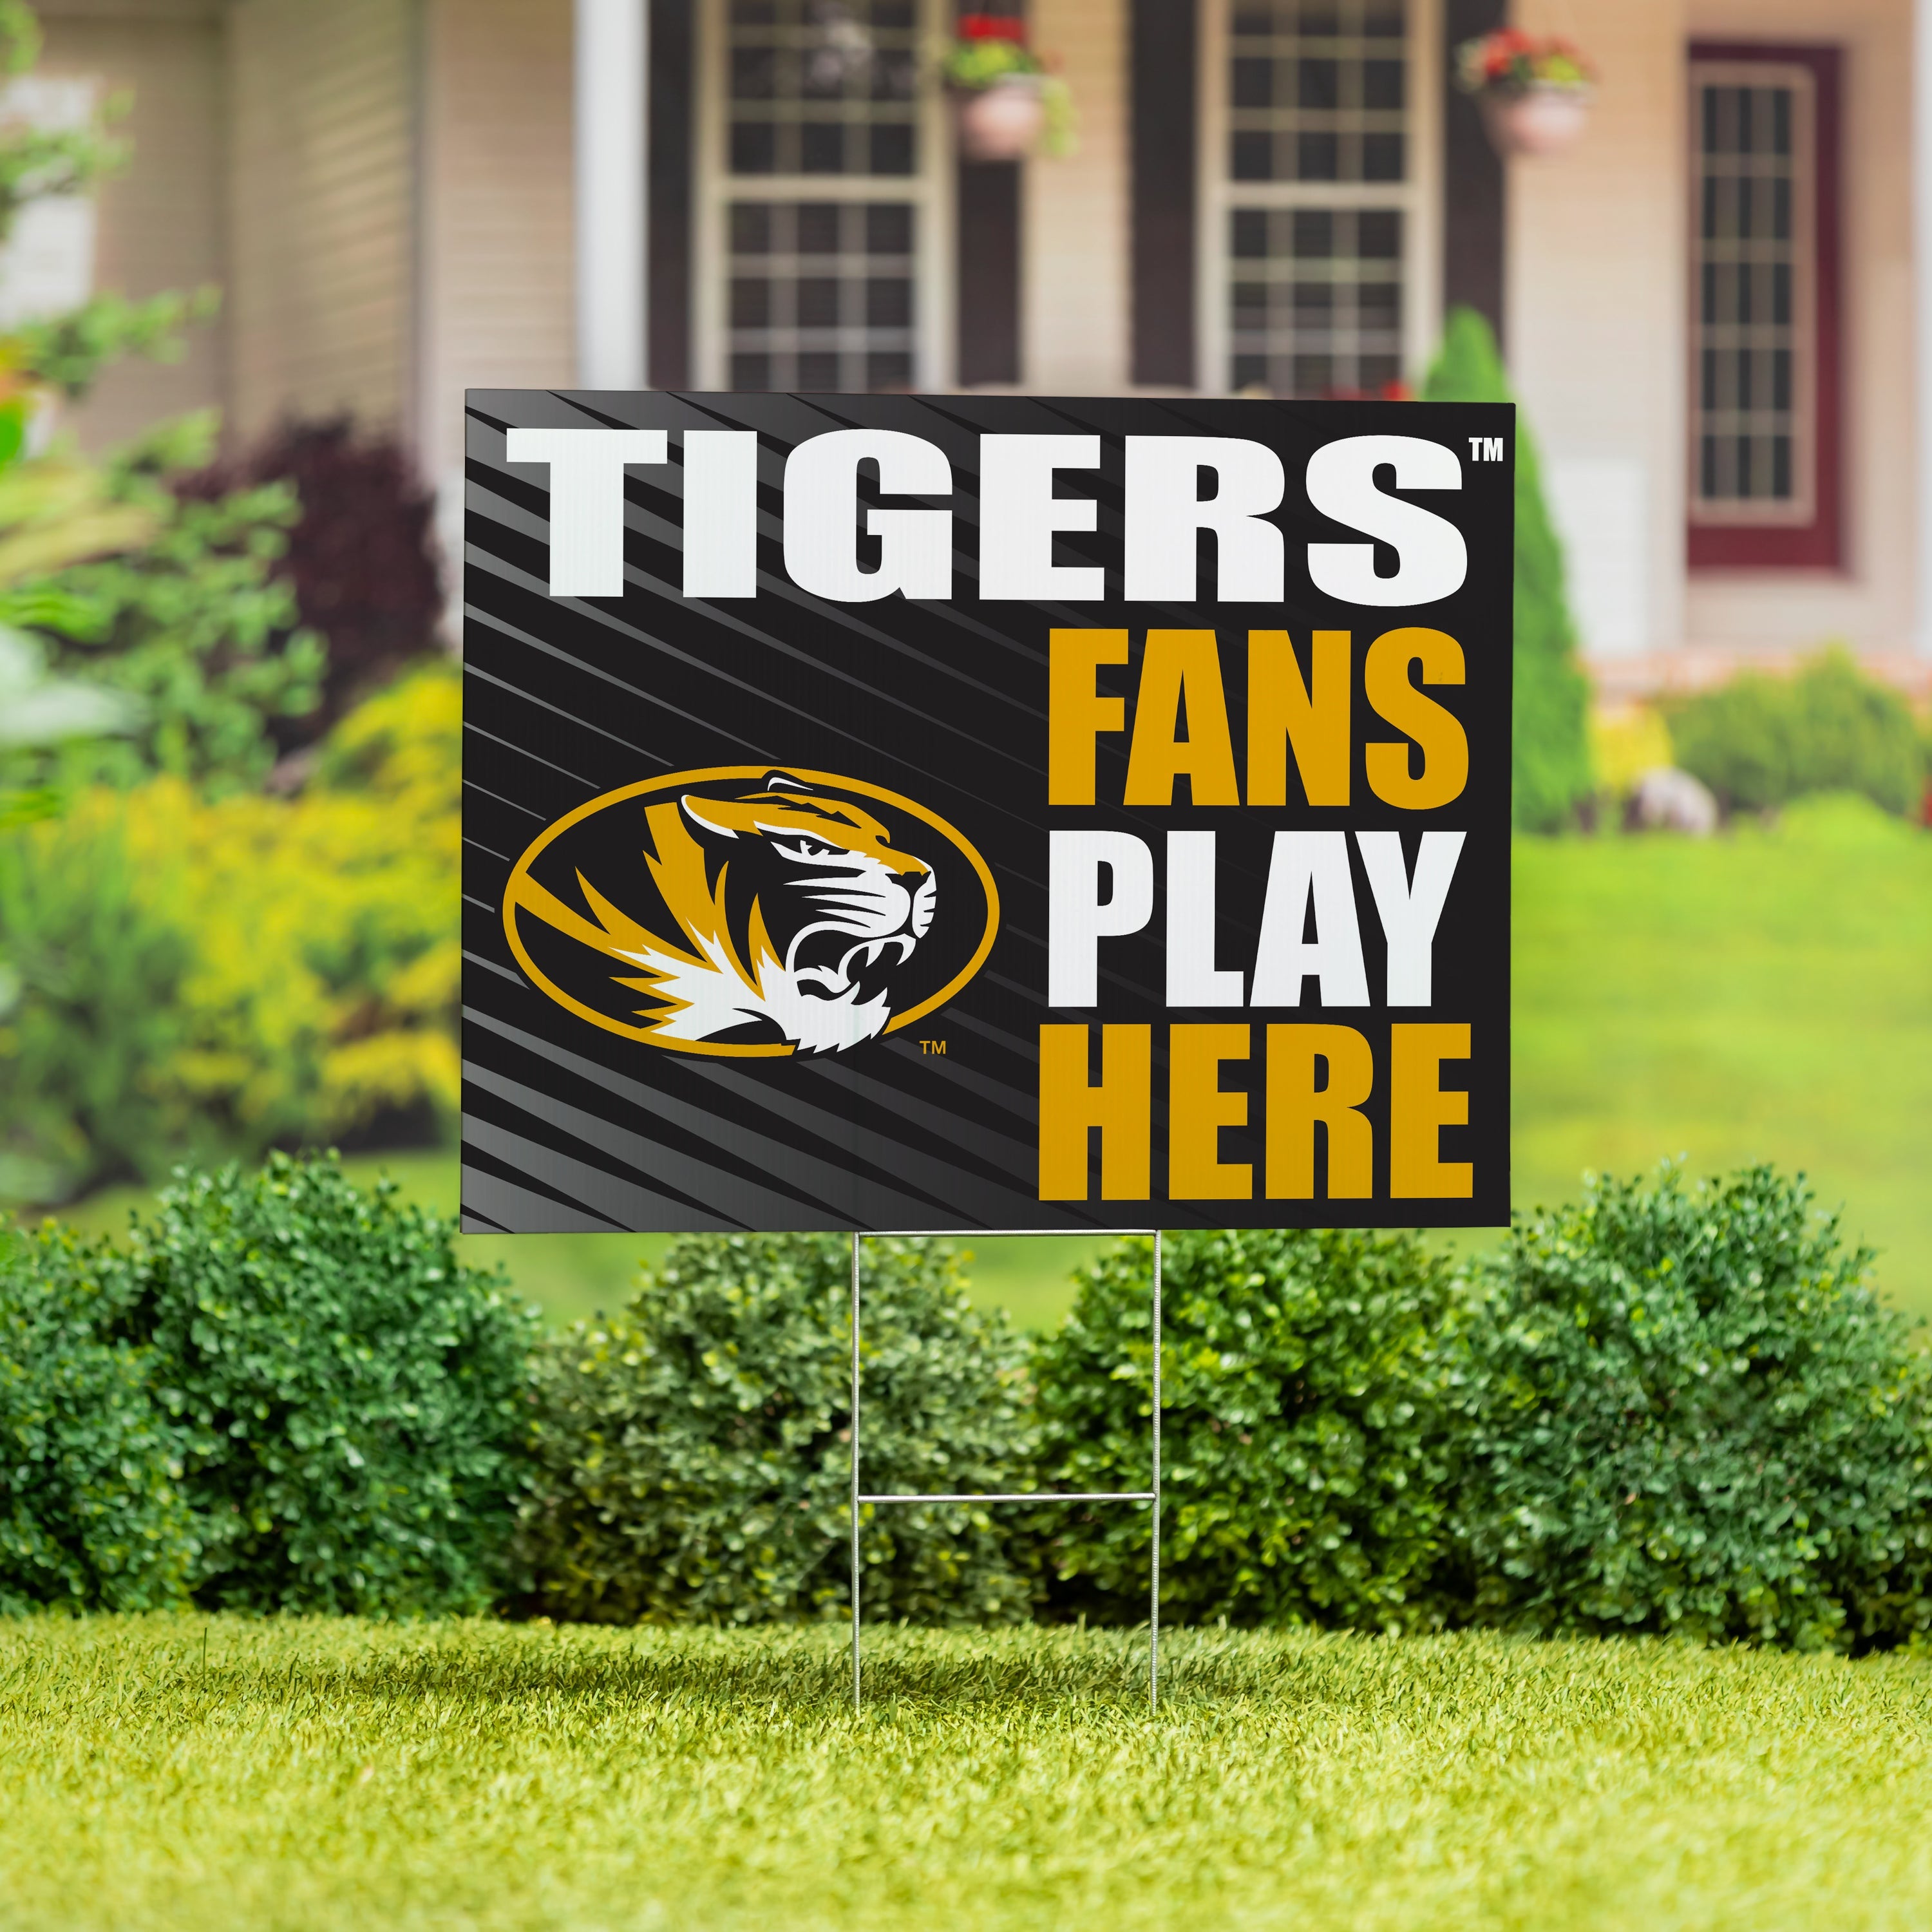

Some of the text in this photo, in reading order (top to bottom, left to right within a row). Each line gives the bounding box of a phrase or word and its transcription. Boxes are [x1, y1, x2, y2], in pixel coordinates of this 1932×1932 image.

[506, 428, 1504, 607] TIGERS TM
[1048, 627, 1470, 810] FANS
[1048, 830, 1467, 1008] PLAY
[919, 1040, 947, 1054] TM
[1038, 1023, 1473, 1201] HERE
